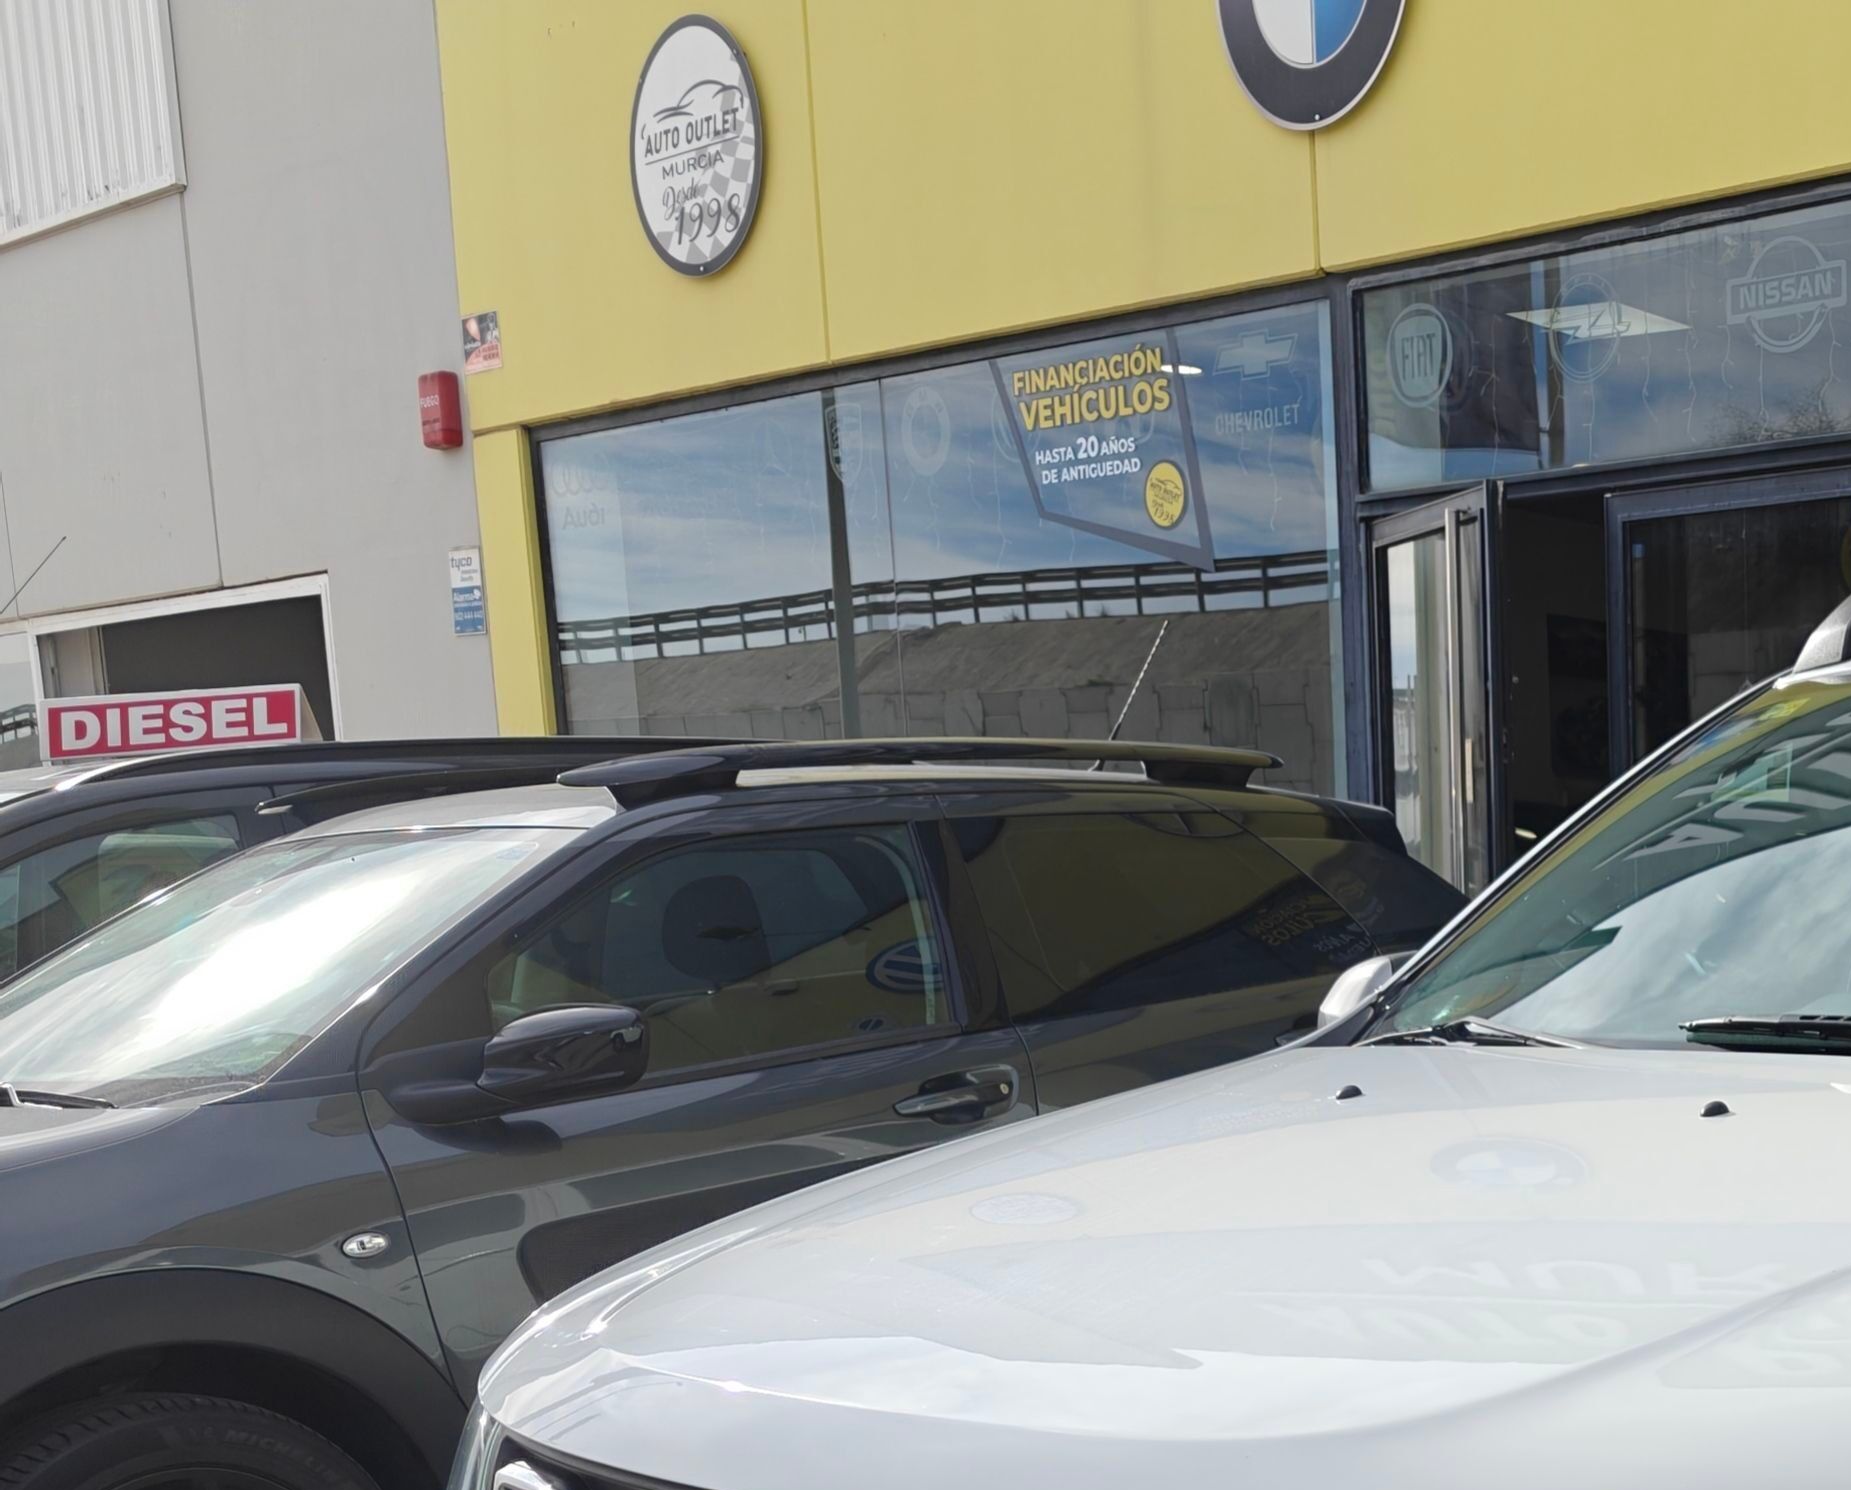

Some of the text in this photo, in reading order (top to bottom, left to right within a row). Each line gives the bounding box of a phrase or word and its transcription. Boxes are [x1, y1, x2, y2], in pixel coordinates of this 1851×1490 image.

[644, 107, 740, 158] AUTO OUTLET
[662, 150, 725, 180] MURCIA
[674, 193, 741, 246] 1998
[1739, 270, 1832, 310] NISSAN
[1012, 343, 1163, 397] FINANCIACIÓN
[1401, 333, 1436, 382] FIAT
[1018, 377, 1171, 432] VEHÍCULOS
[1214, 403, 1301, 437] CHEVROLET
[1035, 435, 1136, 466] HASTA 20 AÑOS
[1041, 457, 1141, 485] DE ANTIGUEDAD
[451, 556, 473, 571] tyco
[60, 696, 288, 751] DIESEL
